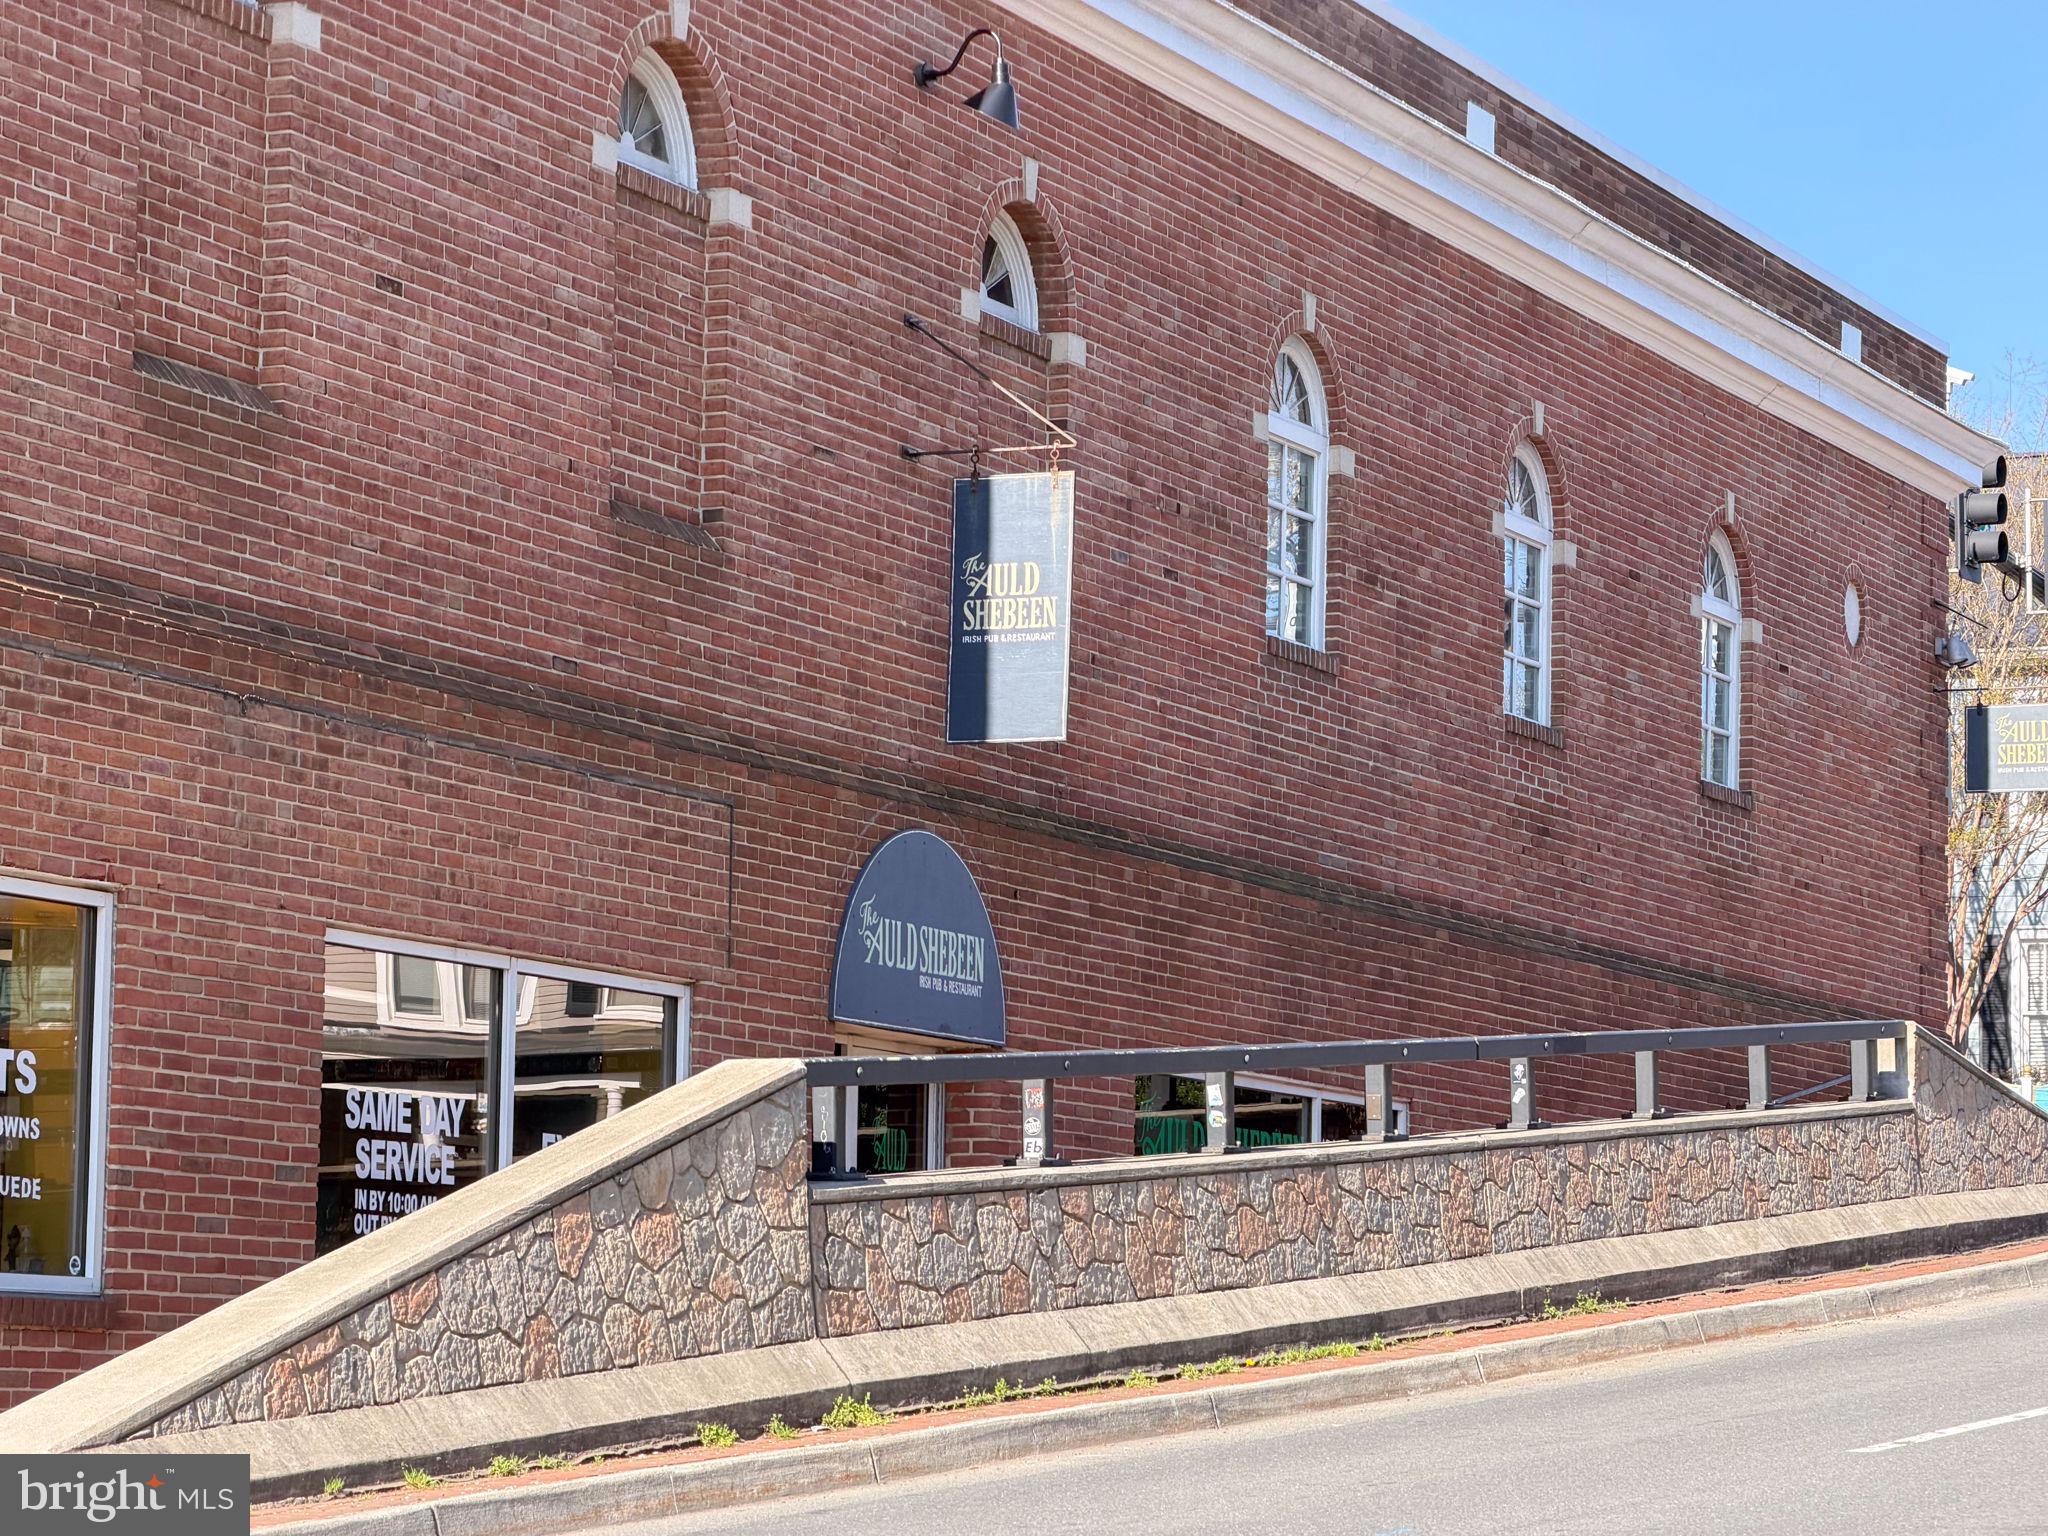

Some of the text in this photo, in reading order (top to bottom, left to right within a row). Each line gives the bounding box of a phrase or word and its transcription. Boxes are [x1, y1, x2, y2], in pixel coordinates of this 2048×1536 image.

[960, 552, 1041, 597] The AULD
[963, 596, 1058, 631] SHEBEEN
[962, 635, 982, 643] IRISH
[983, 634, 999, 643] PUB
[1007, 631, 1056, 642] RESTAURANT
[1994, 712, 2012, 732] The
[1997, 743, 2048, 765] SHEBE
[858, 893, 985, 983] The AULD SHEBEEN
[919, 975, 931, 990] IRISH
[932, 977, 943, 992] PUB
[948, 980, 983, 998] RESTAURANT
[345, 1087, 466, 1138] SAME DAY
[354, 1137, 456, 1186] SERVICE
[873, 1127, 908, 1172] AULD
[354, 1188, 368, 1211] IN
[368, 1189, 386, 1212] BY
[387, 1191, 418, 1214] 10:00
[354, 1213, 380, 1235] OUT
